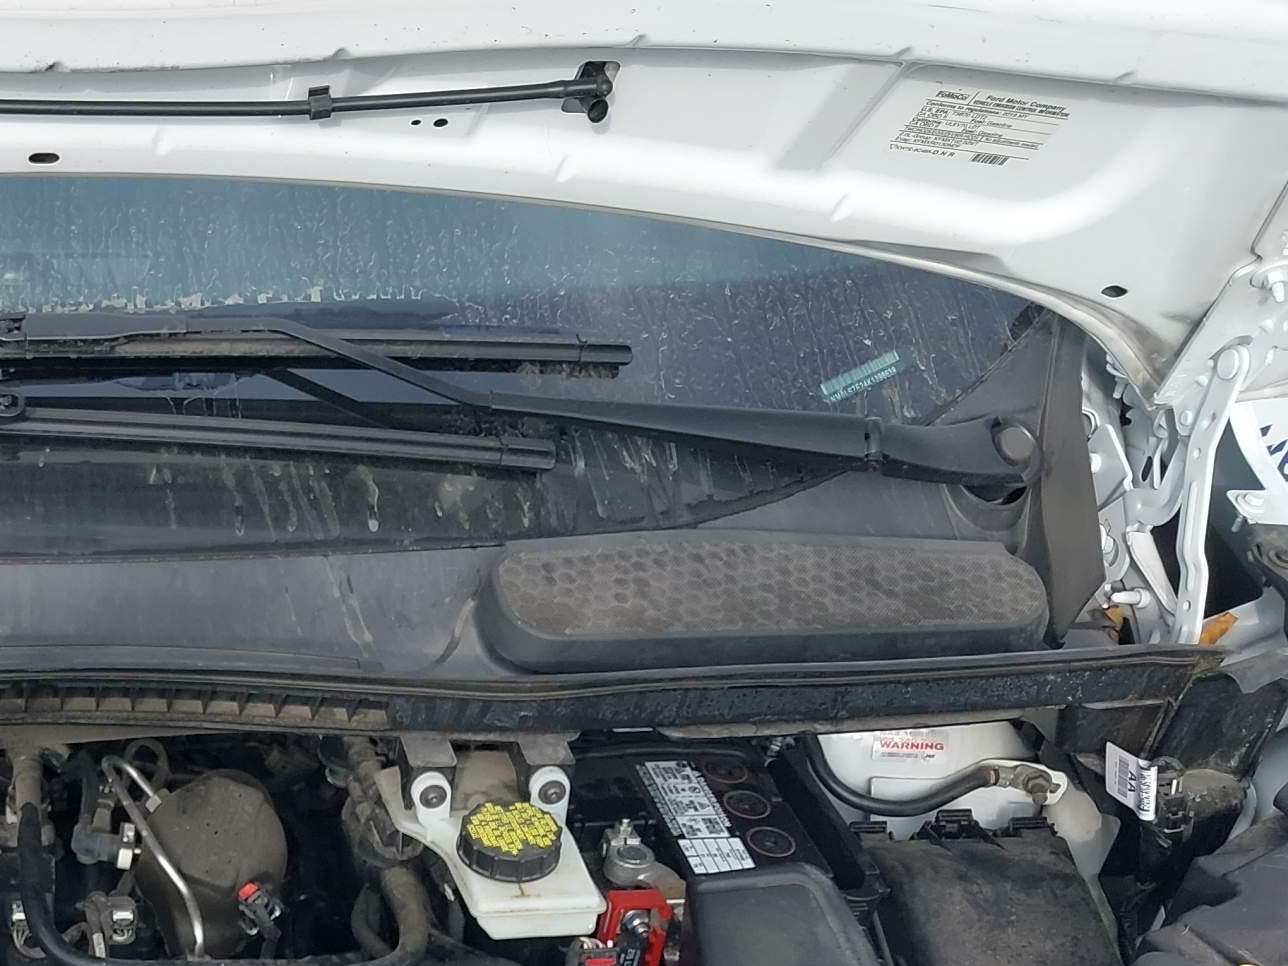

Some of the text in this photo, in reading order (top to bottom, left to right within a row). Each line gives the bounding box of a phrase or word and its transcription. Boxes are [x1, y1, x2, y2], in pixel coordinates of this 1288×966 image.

[936, 90, 970, 101] FoMoCo
[986, 95, 1067, 112] Ford Motor Company
[880, 740, 944, 750] WARNING
